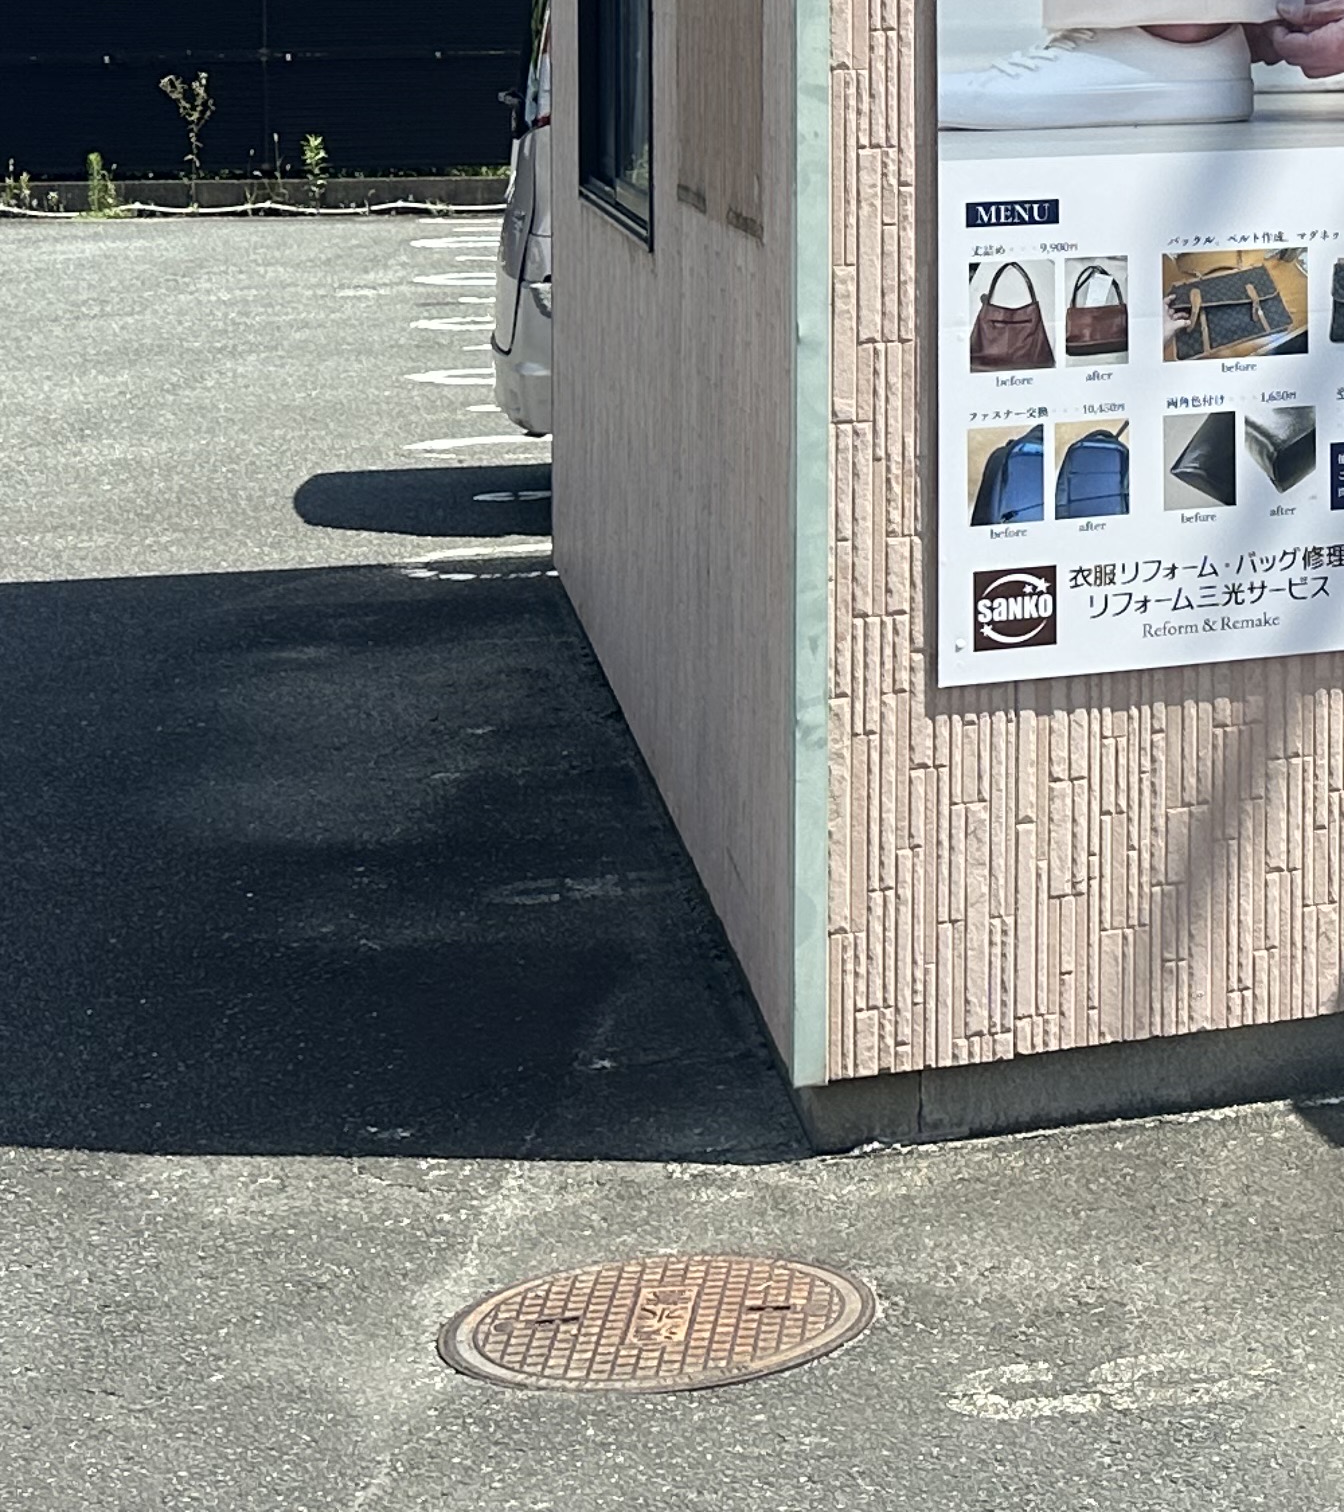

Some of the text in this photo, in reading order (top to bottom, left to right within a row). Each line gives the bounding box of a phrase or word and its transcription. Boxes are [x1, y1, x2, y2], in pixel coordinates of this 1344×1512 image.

[976, 203, 1050, 224] MENU
[1221, 362, 1257, 373] before
[1086, 371, 1113, 382] after
[1269, 505, 1298, 517] after
[1180, 512, 1218, 524] before
[1079, 521, 1107, 532] after
[990, 527, 1028, 539] before
[1089, 575, 1331, 620] リフォーム三光サービス
[1141, 613, 1281, 639] Reform & Remake
